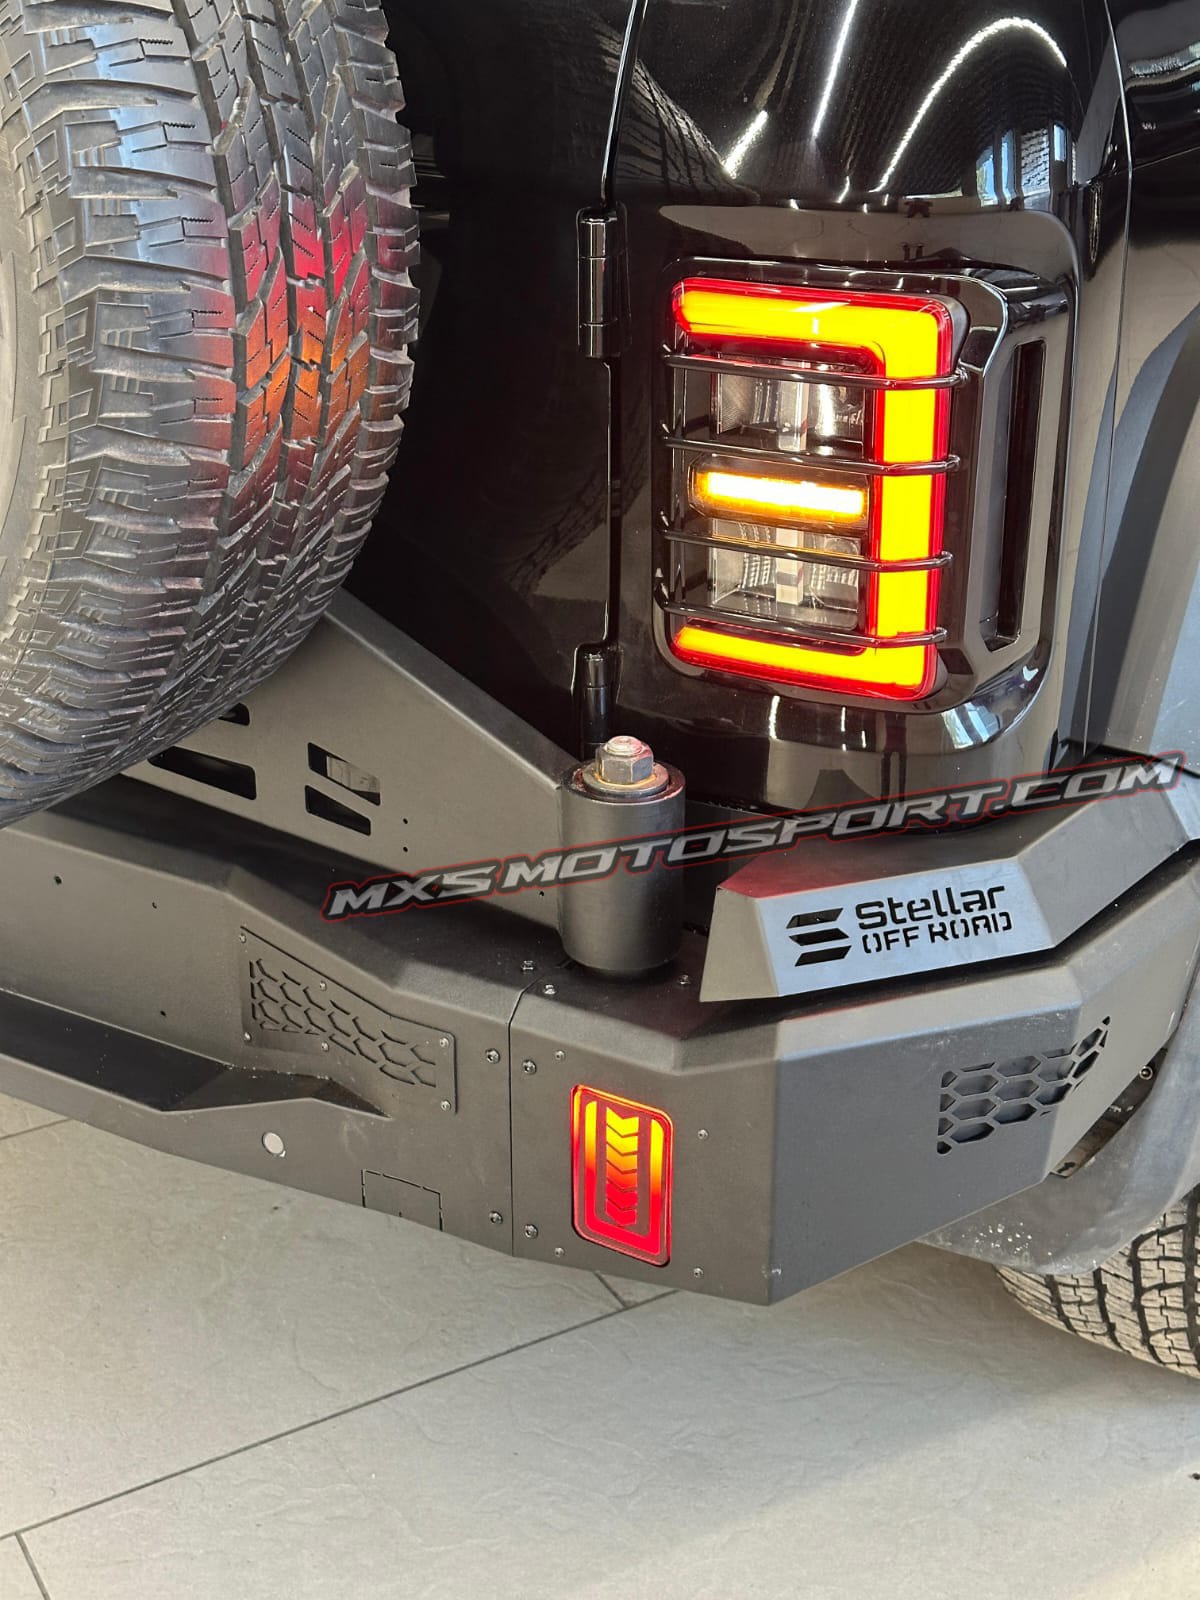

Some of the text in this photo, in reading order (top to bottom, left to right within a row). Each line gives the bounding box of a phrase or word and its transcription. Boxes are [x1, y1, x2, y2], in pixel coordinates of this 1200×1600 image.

[855, 885, 1006, 931] Stellar
[861, 910, 1013, 955] OFF ROAD
